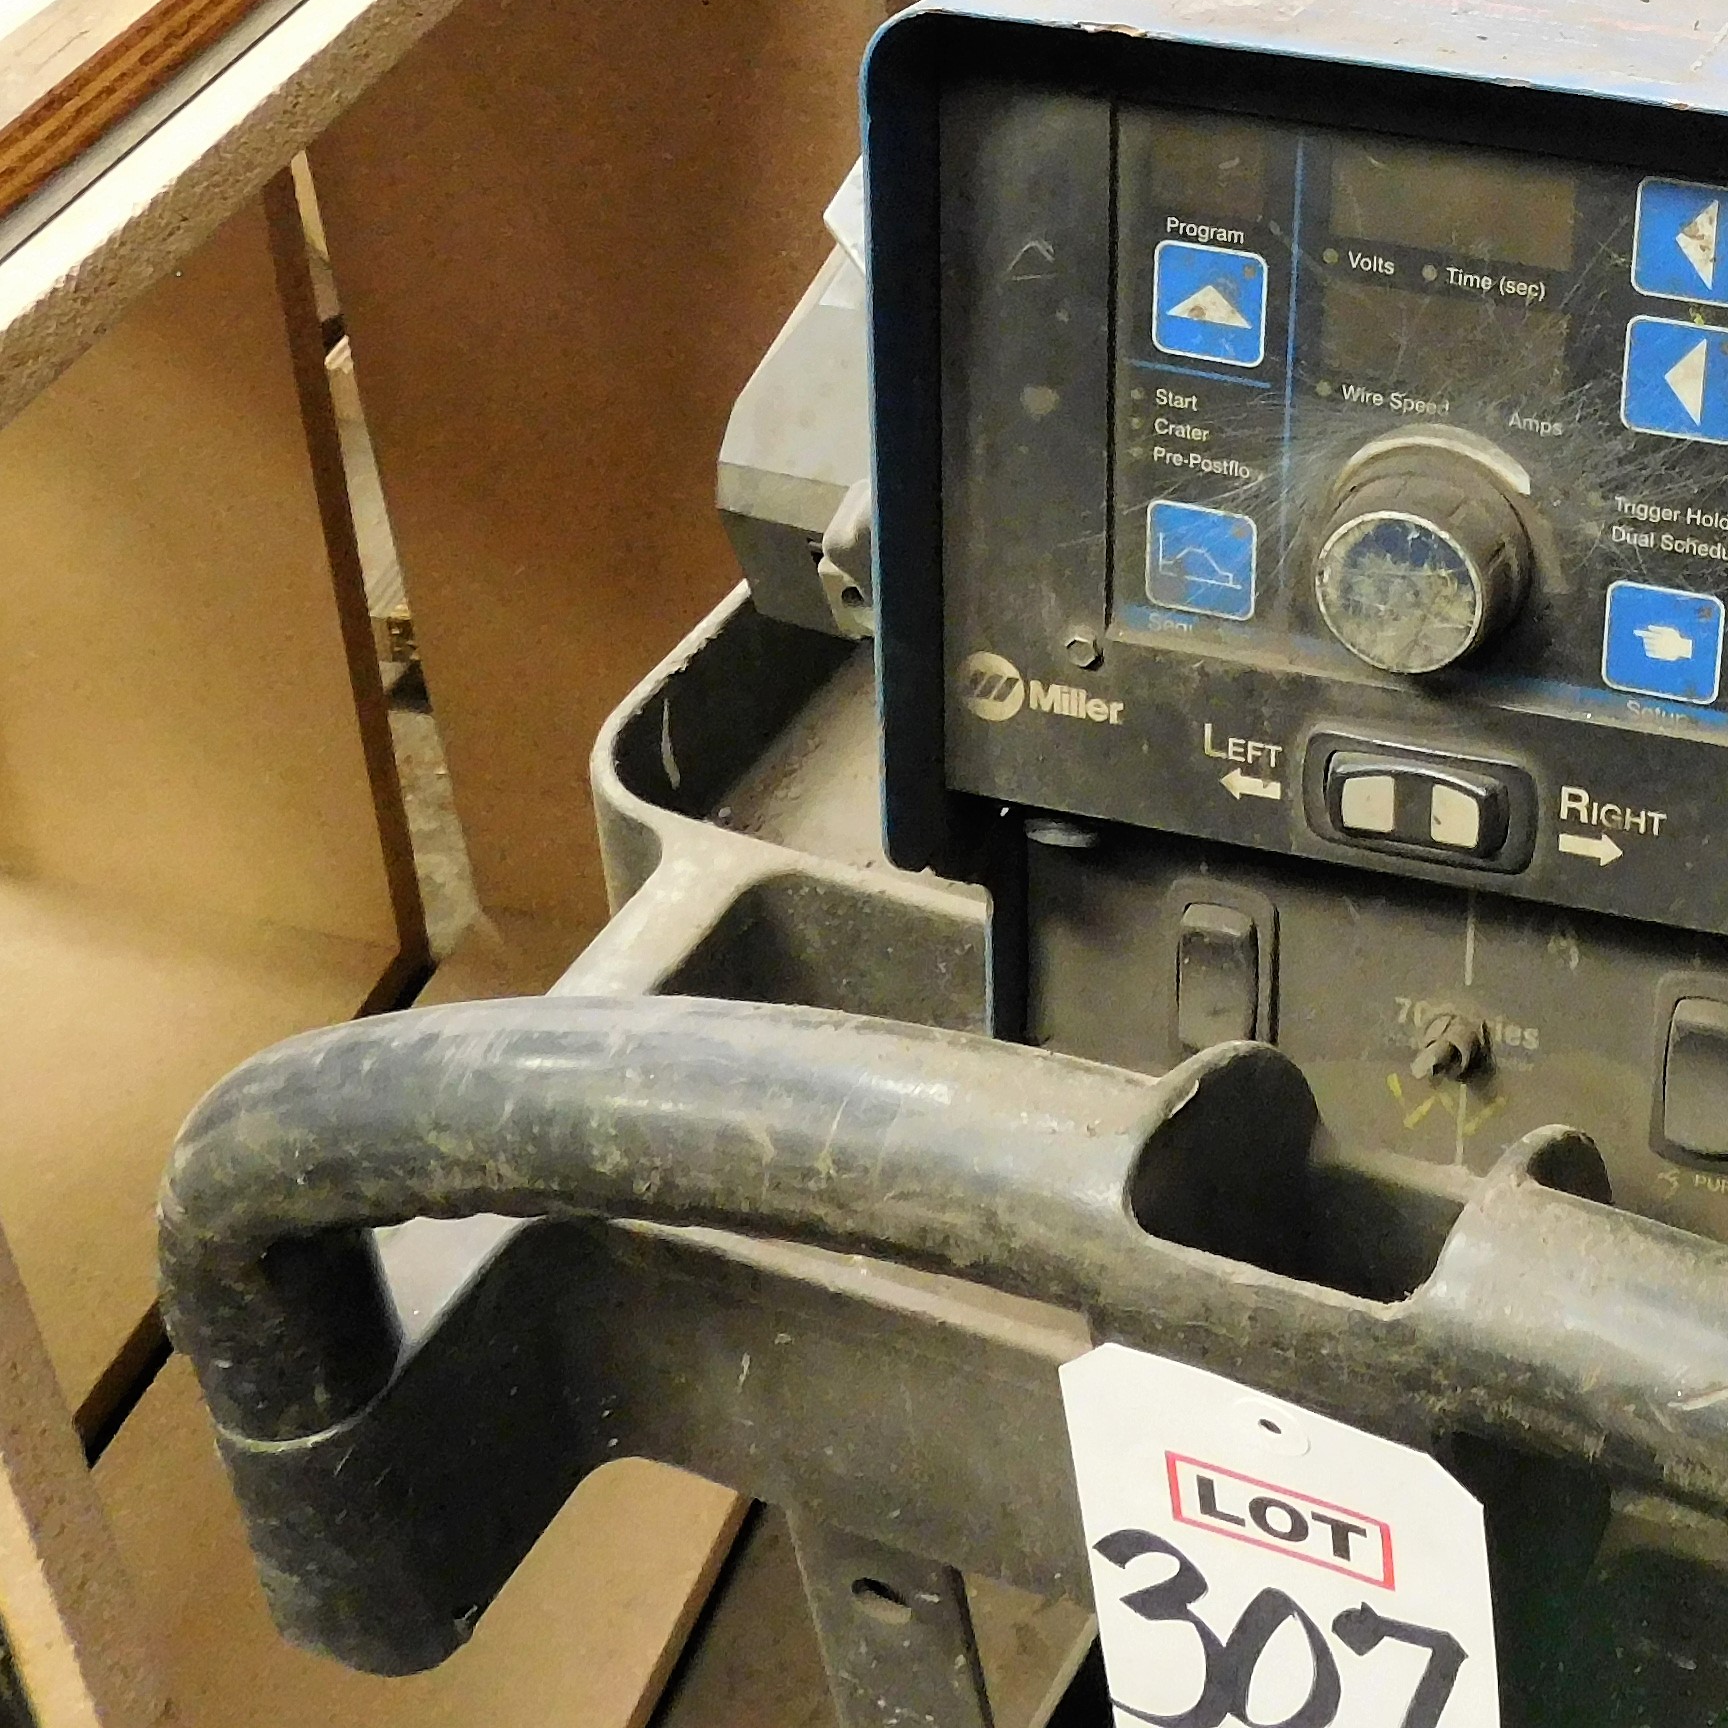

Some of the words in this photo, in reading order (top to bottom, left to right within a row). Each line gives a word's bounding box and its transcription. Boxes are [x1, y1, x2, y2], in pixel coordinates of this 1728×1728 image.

[1166, 216, 1245, 244] Program
[1348, 251, 1395, 275] Volts
[1446, 266, 1493, 291] Time
[1499, 276, 1546, 302] (sec)
[1156, 388, 1198, 411] Start
[1341, 384, 1384, 406] Wire
[1388, 391, 1450, 416] Speed
[1154, 418, 1210, 442] Crater
[1508, 412, 1563, 438] Amps
[1153, 446, 1256, 479] Pre-Postflo
[1615, 495, 1681, 523] Trigger
[1611, 525, 1655, 548] Dual
[1029, 679, 1126, 725] Miller
[1203, 722, 1283, 768] LEFT
[1559, 785, 1667, 836] RIGHT
[1195, 1474, 1367, 1562] LOT
[1092, 1528, 1469, 1728] 307
